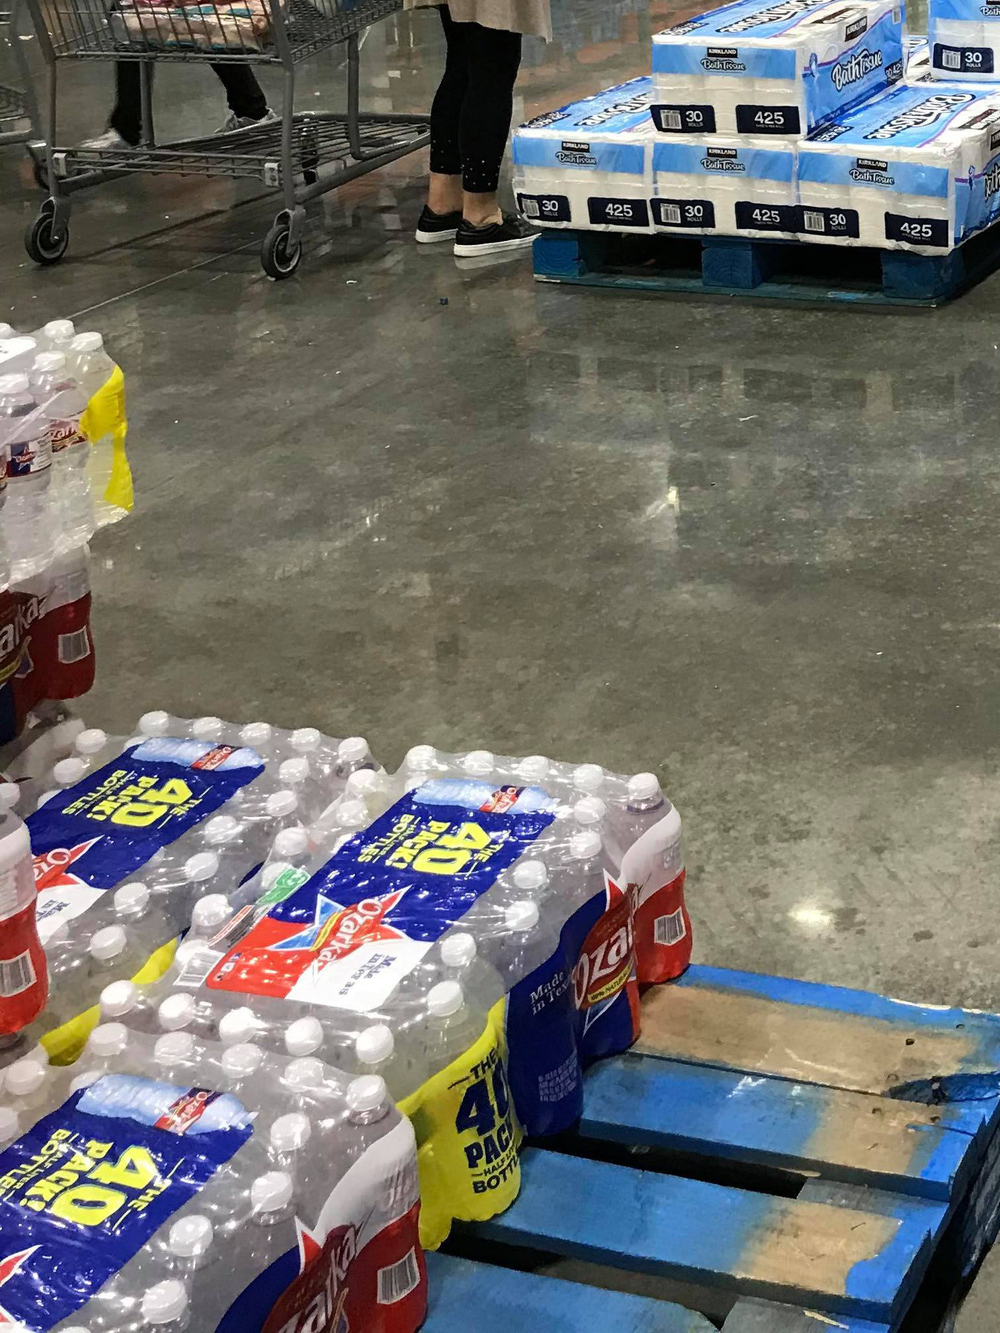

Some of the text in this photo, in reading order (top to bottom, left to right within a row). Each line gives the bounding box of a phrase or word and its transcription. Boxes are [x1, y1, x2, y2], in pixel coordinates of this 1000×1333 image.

[846, 18, 867, 35] KIRKLAND
[709, 48, 737, 56] KIRKLAND
[965, 52, 982, 63] 30
[686, 110, 703, 122] 30
[754, 111, 785, 124] 425
[562, 142, 589, 150] KIRKLAND
[858, 159, 887, 168] KIRKLAND
[541, 200, 559, 211] 30
[605, 203, 633, 216] 425
[685, 205, 703, 217] 30
[752, 210, 780, 223] 425
[829, 214, 846, 225] 30
[900, 223, 932, 237] 425
[62, 769, 128, 815] BOTTLES
[86, 775, 160, 821] PACK!
[111, 778, 193, 827] 40
[170, 796, 203, 816] THE
[358, 813, 415, 863] BOTTLES
[385, 819, 451, 870] PACK!
[412, 821, 492, 875] 40
[473, 842, 504, 863] THE
[319, 897, 384, 965] Ozarka
[529, 971, 564, 1004] Made
[533, 1000, 546, 1016] in
[470, 1048, 496, 1079] THE
[19, 1139, 115, 1212] PACK!
[484, 1156, 506, 1177] HALF
[51, 1145, 158, 1227] 40
[128, 1178, 173, 1211] THE
